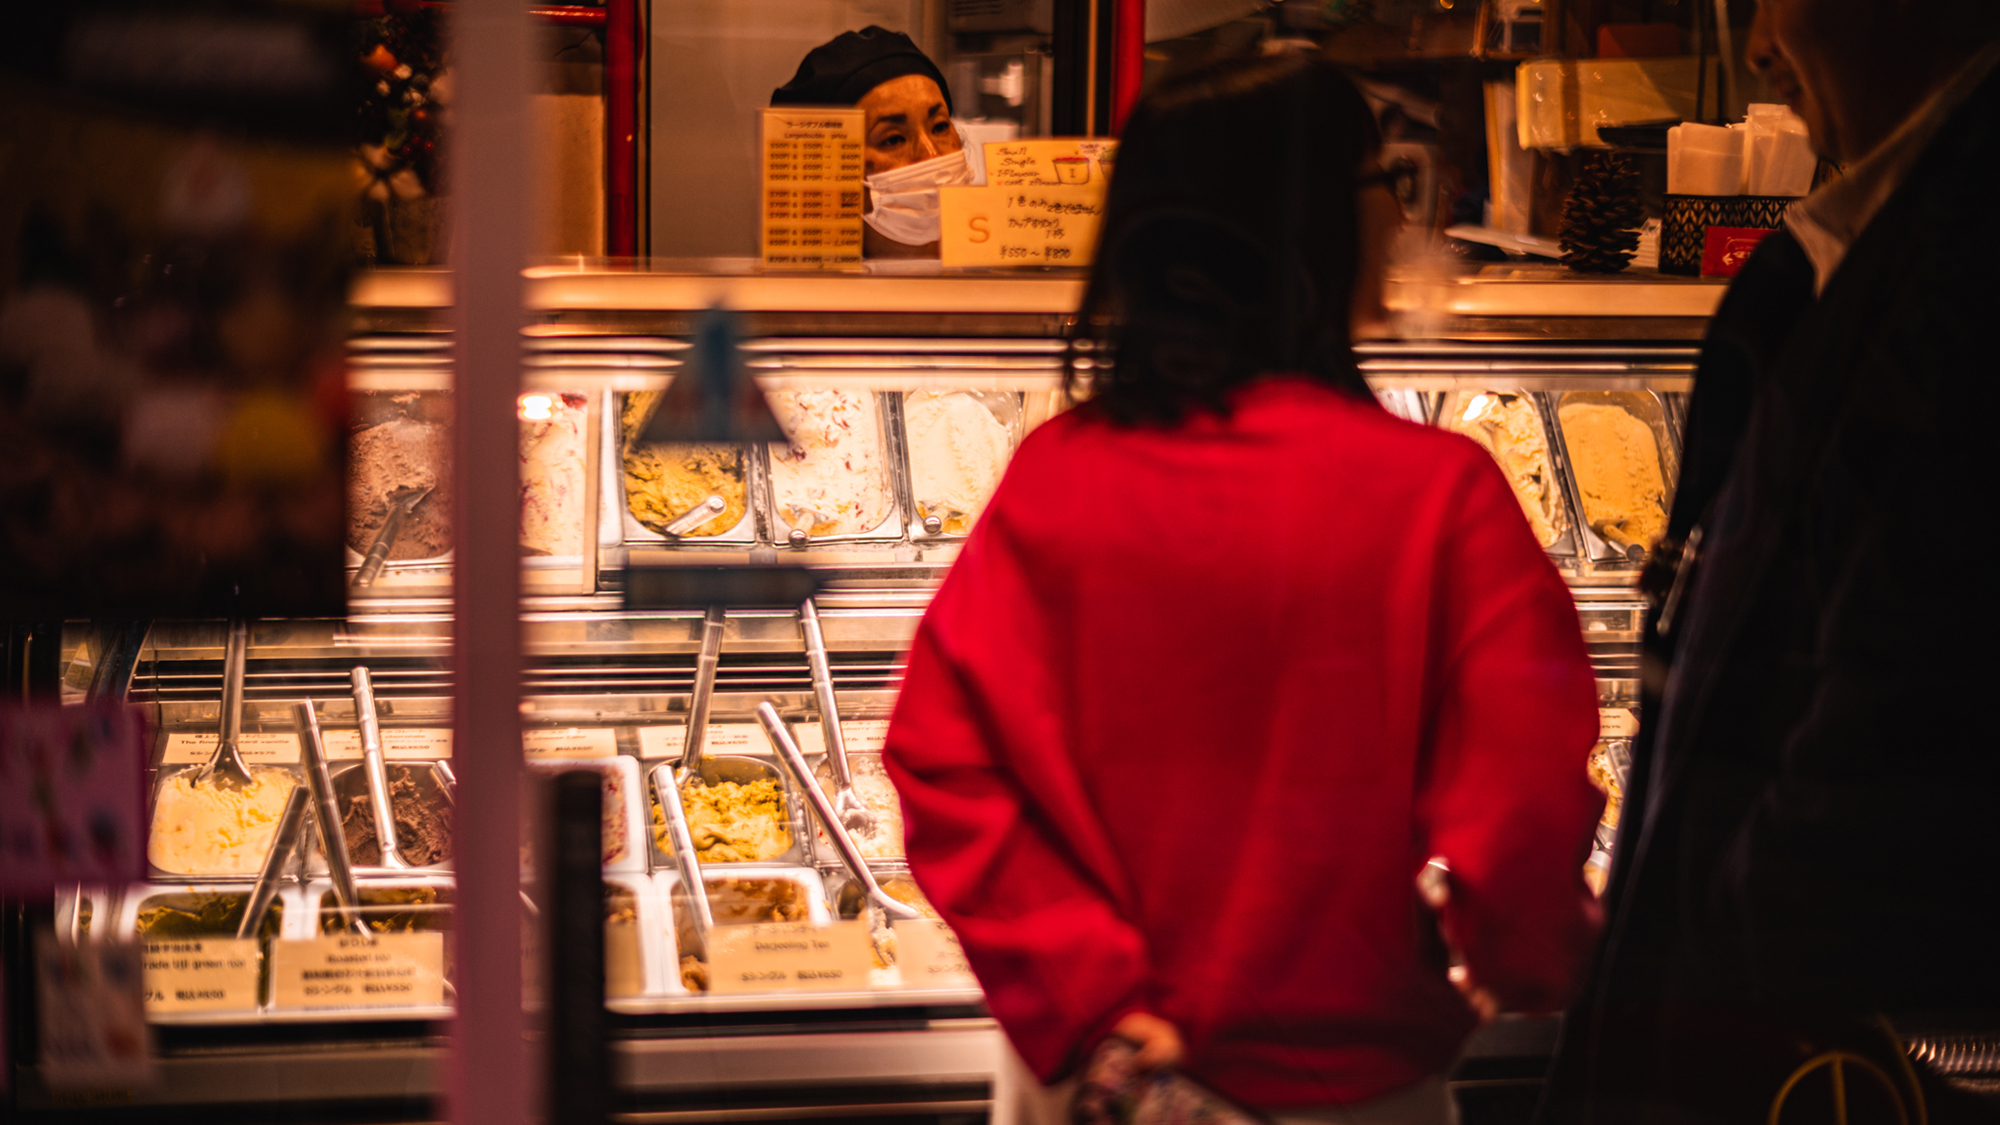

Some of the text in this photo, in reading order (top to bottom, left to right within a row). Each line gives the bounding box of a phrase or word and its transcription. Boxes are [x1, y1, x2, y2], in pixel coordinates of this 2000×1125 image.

[997, 147, 1026, 156] Small
[1001, 157, 1037, 168] Single
[968, 216, 991, 244] S
[755, 939, 830, 951] Darjeeling Tea
